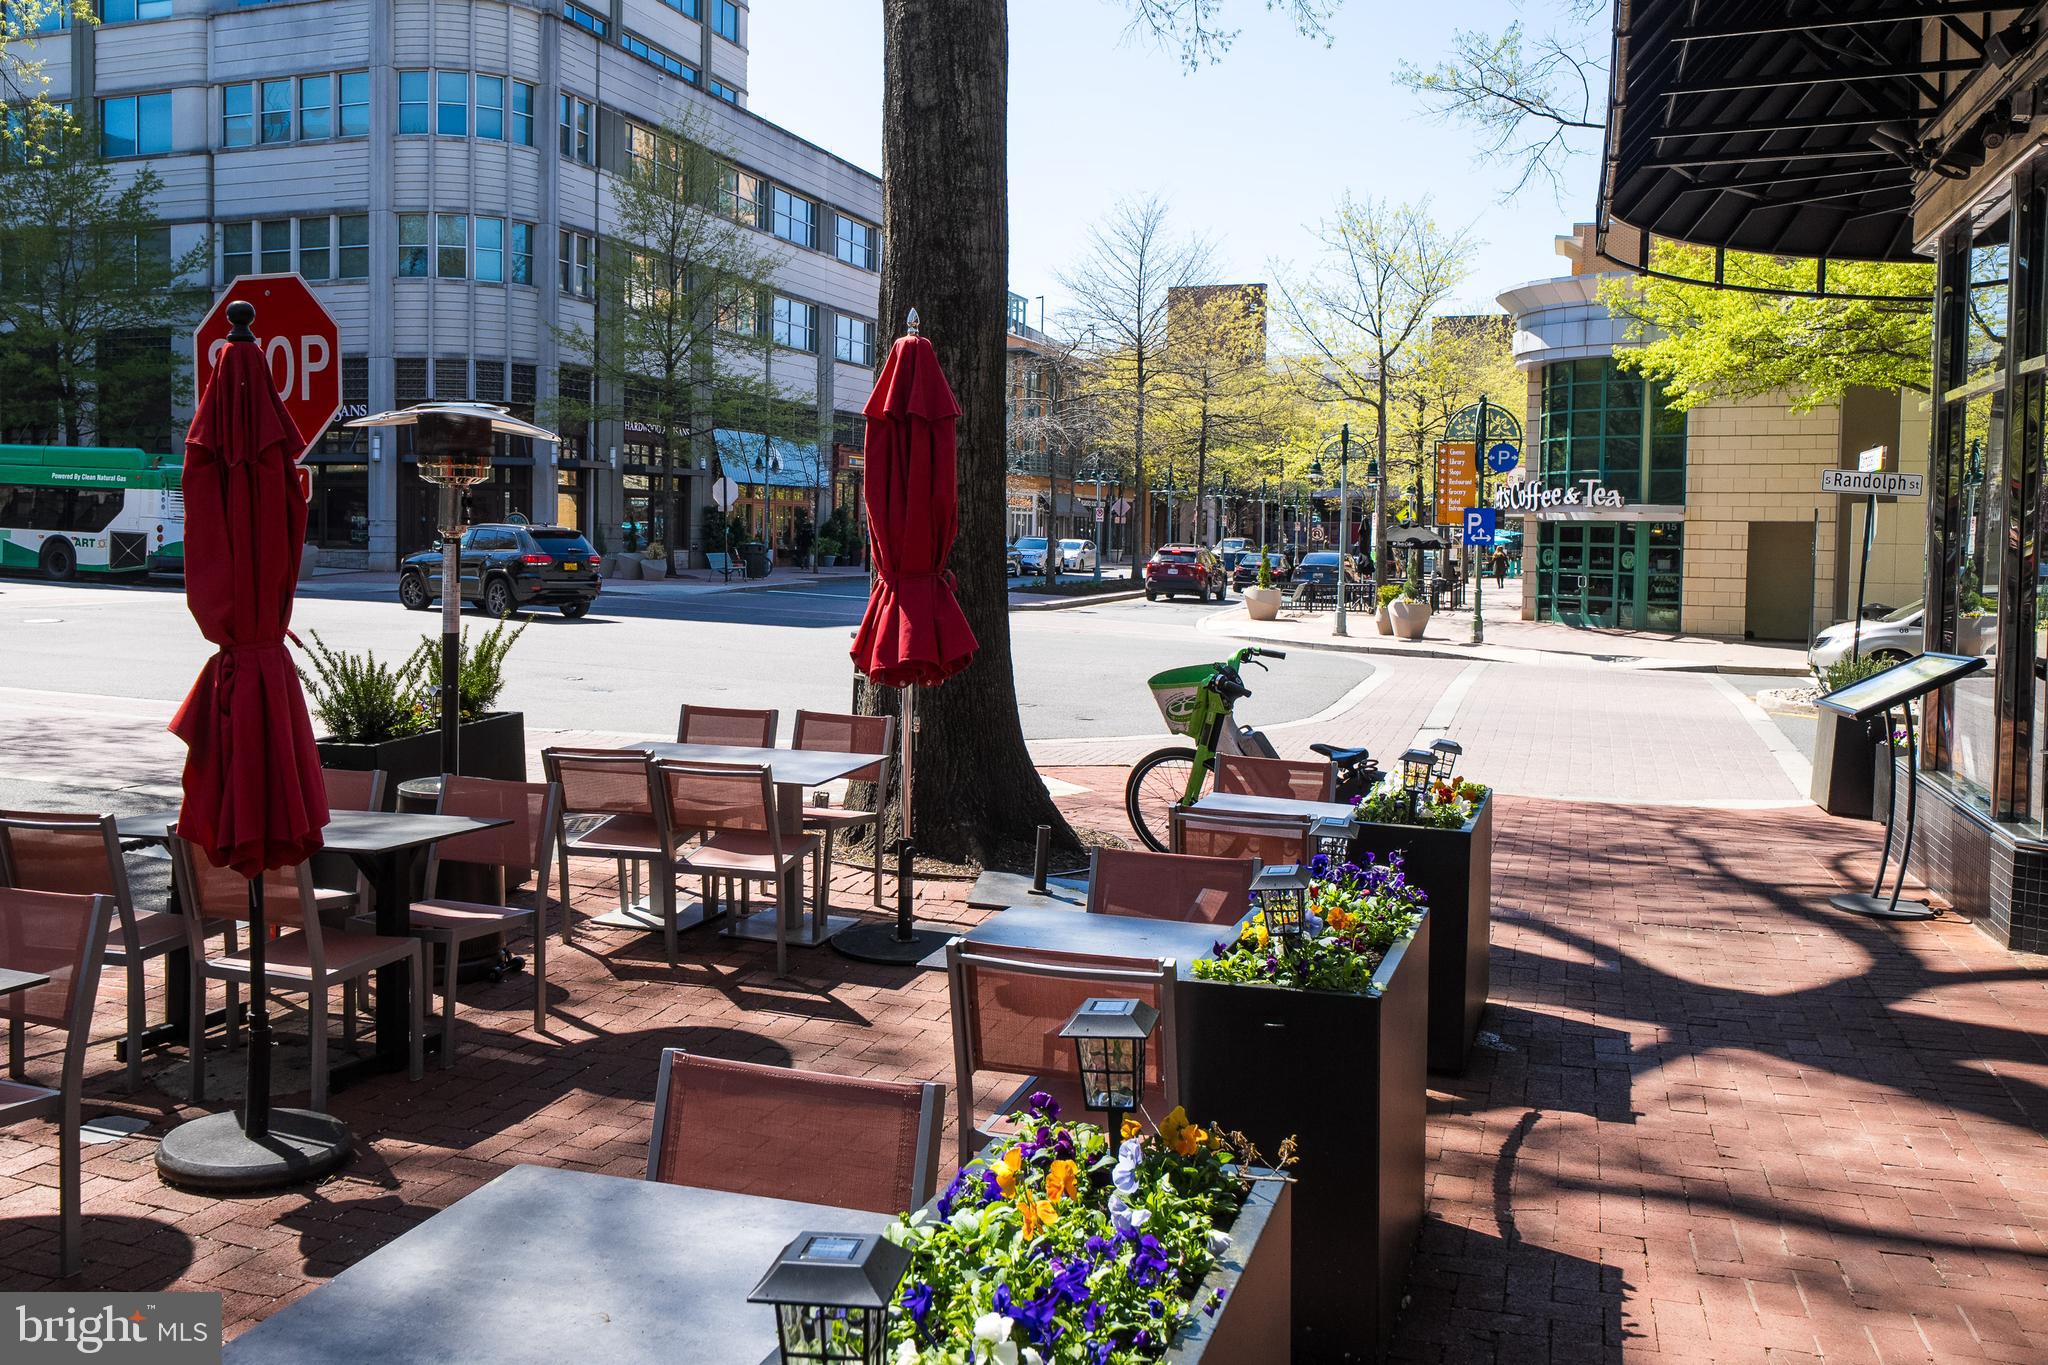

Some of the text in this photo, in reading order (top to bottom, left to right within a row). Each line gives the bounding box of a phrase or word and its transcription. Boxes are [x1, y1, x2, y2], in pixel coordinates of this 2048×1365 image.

[208, 335, 330, 402] OP
[1449, 458, 1465, 466] Library
[1498, 450, 1510, 465] P
[51, 472, 73, 480] Powered
[74, 473, 81, 481] By
[1448, 468, 1462, 476] Shops
[1825, 476, 1831, 485] S
[1834, 473, 1906, 493] Randolph
[1510, 480, 1562, 512] Coffee
[1563, 486, 1581, 505] &
[1579, 478, 1624, 508] Tea
[1468, 513, 1482, 534] P
[75, 538, 96, 548] ART
